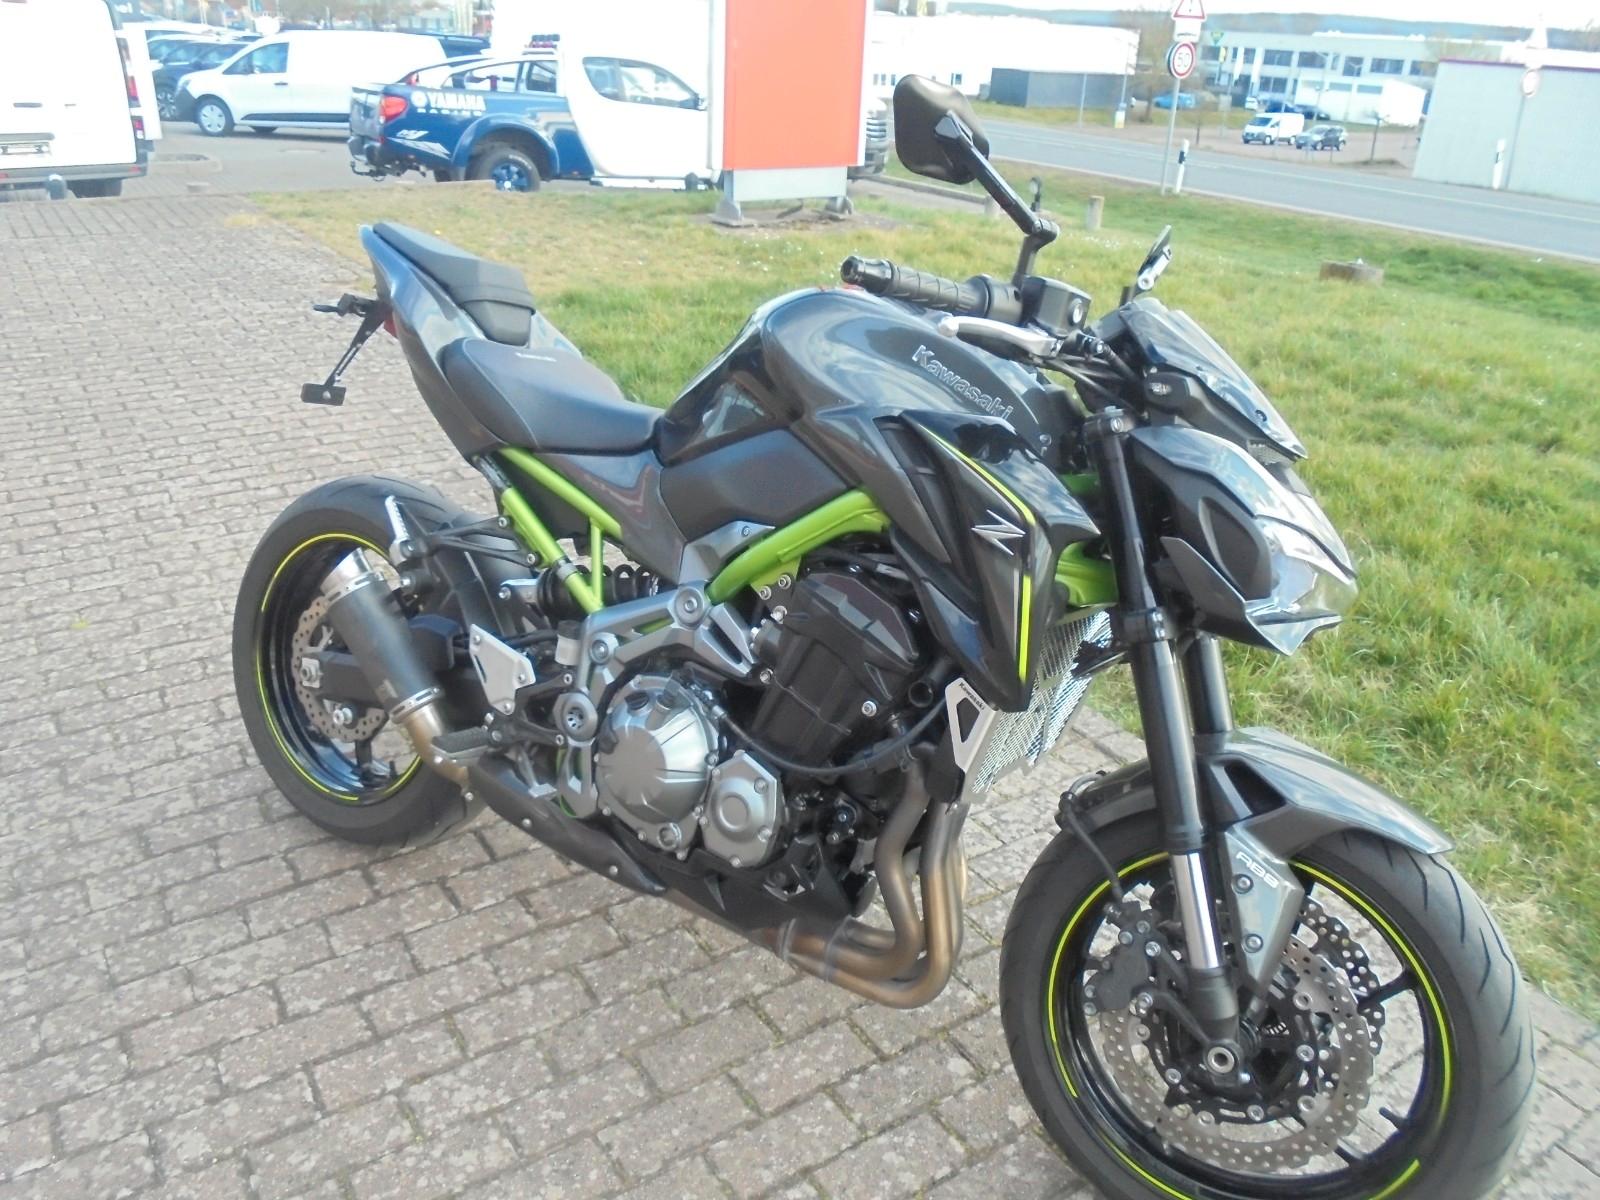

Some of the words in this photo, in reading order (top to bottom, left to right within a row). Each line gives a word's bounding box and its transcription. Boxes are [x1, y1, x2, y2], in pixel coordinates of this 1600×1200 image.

[1176, 52, 1190, 68] 50
[427, 91, 486, 111] YAMAHA
[911, 344, 1014, 420] Kawasaki
[1236, 851, 1280, 889] ABS
